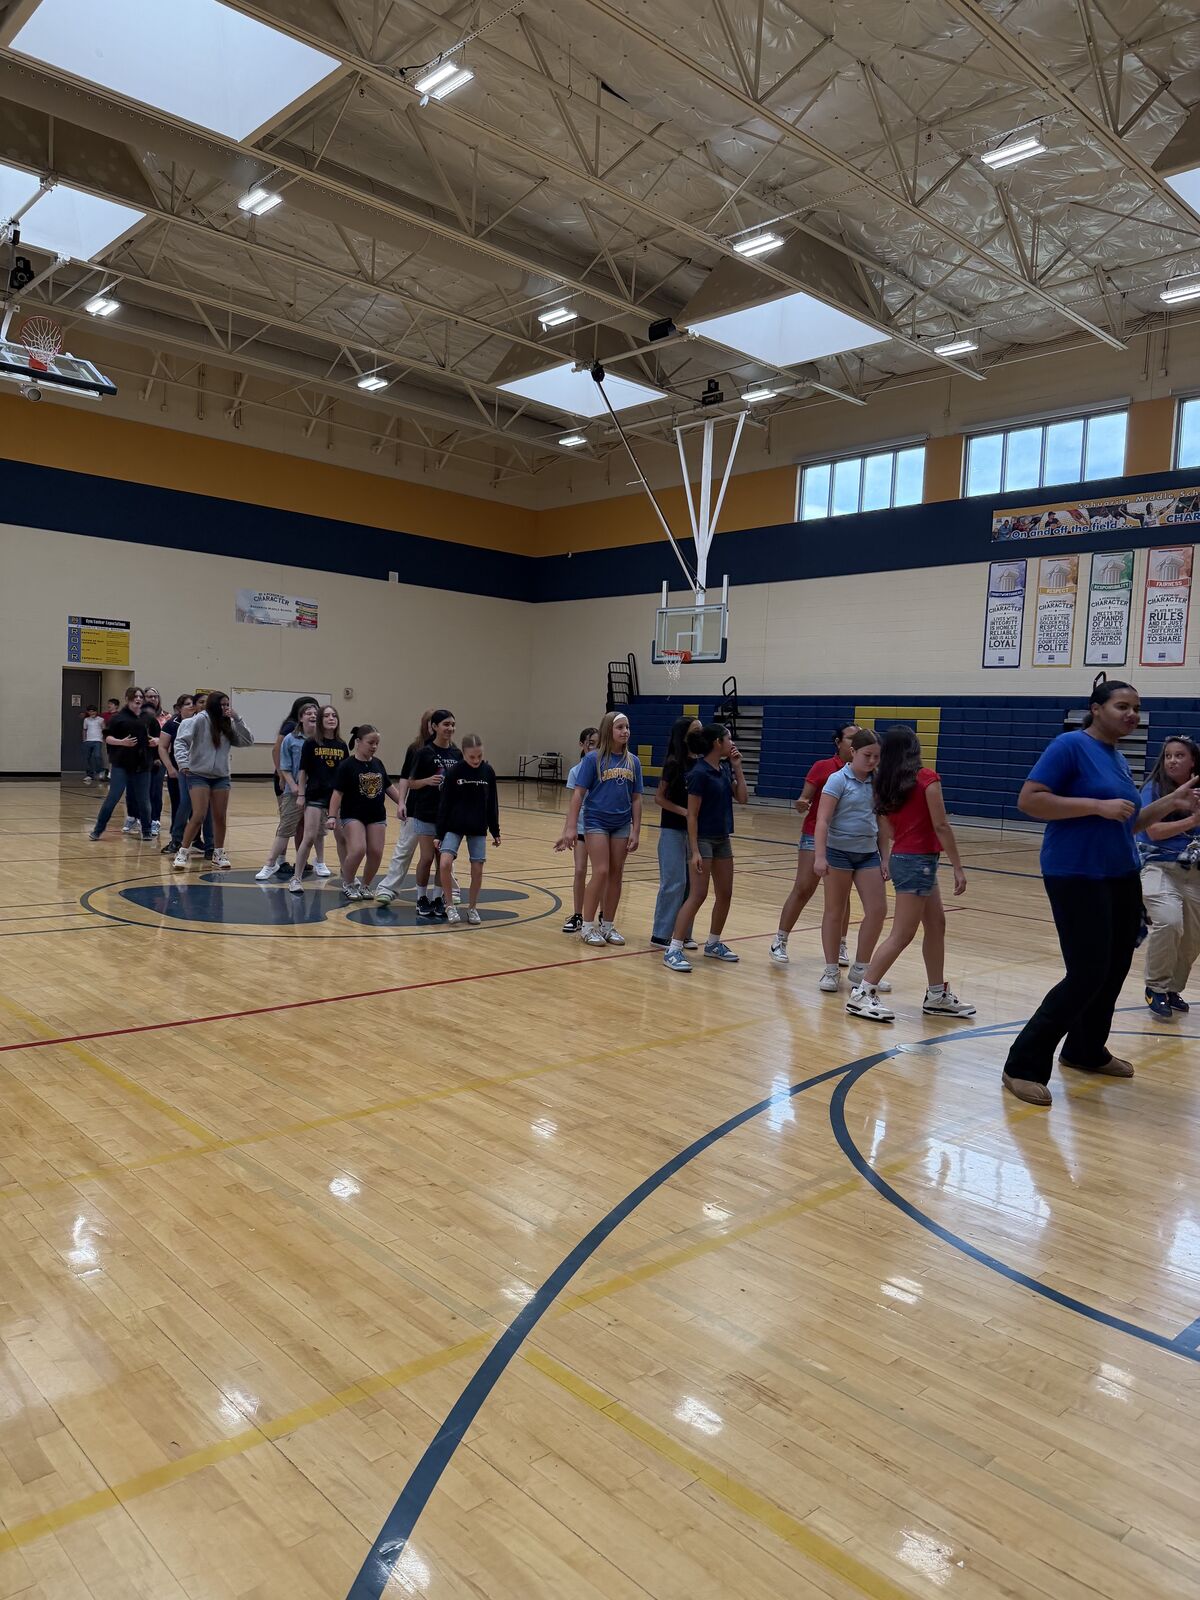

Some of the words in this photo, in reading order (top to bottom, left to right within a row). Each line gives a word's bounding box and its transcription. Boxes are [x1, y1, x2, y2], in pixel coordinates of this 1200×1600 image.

[1135, 493, 1175, 502] Middle
[1011, 530, 1028, 540] On
[1029, 527, 1051, 537] and
[1053, 525, 1069, 535] off
[1070, 524, 1089, 533] the
[1091, 520, 1117, 531] field
[253, 595, 290, 606] CHARACTER
[1091, 599, 1129, 608] CHARACTER
[1147, 596, 1187, 605] CHARACTER
[989, 605, 1022, 613] CHARACTER
[1039, 603, 1074, 611] CHARACTER
[1149, 611, 1184, 621] RULES
[989, 640, 1017, 648] LOYAL
